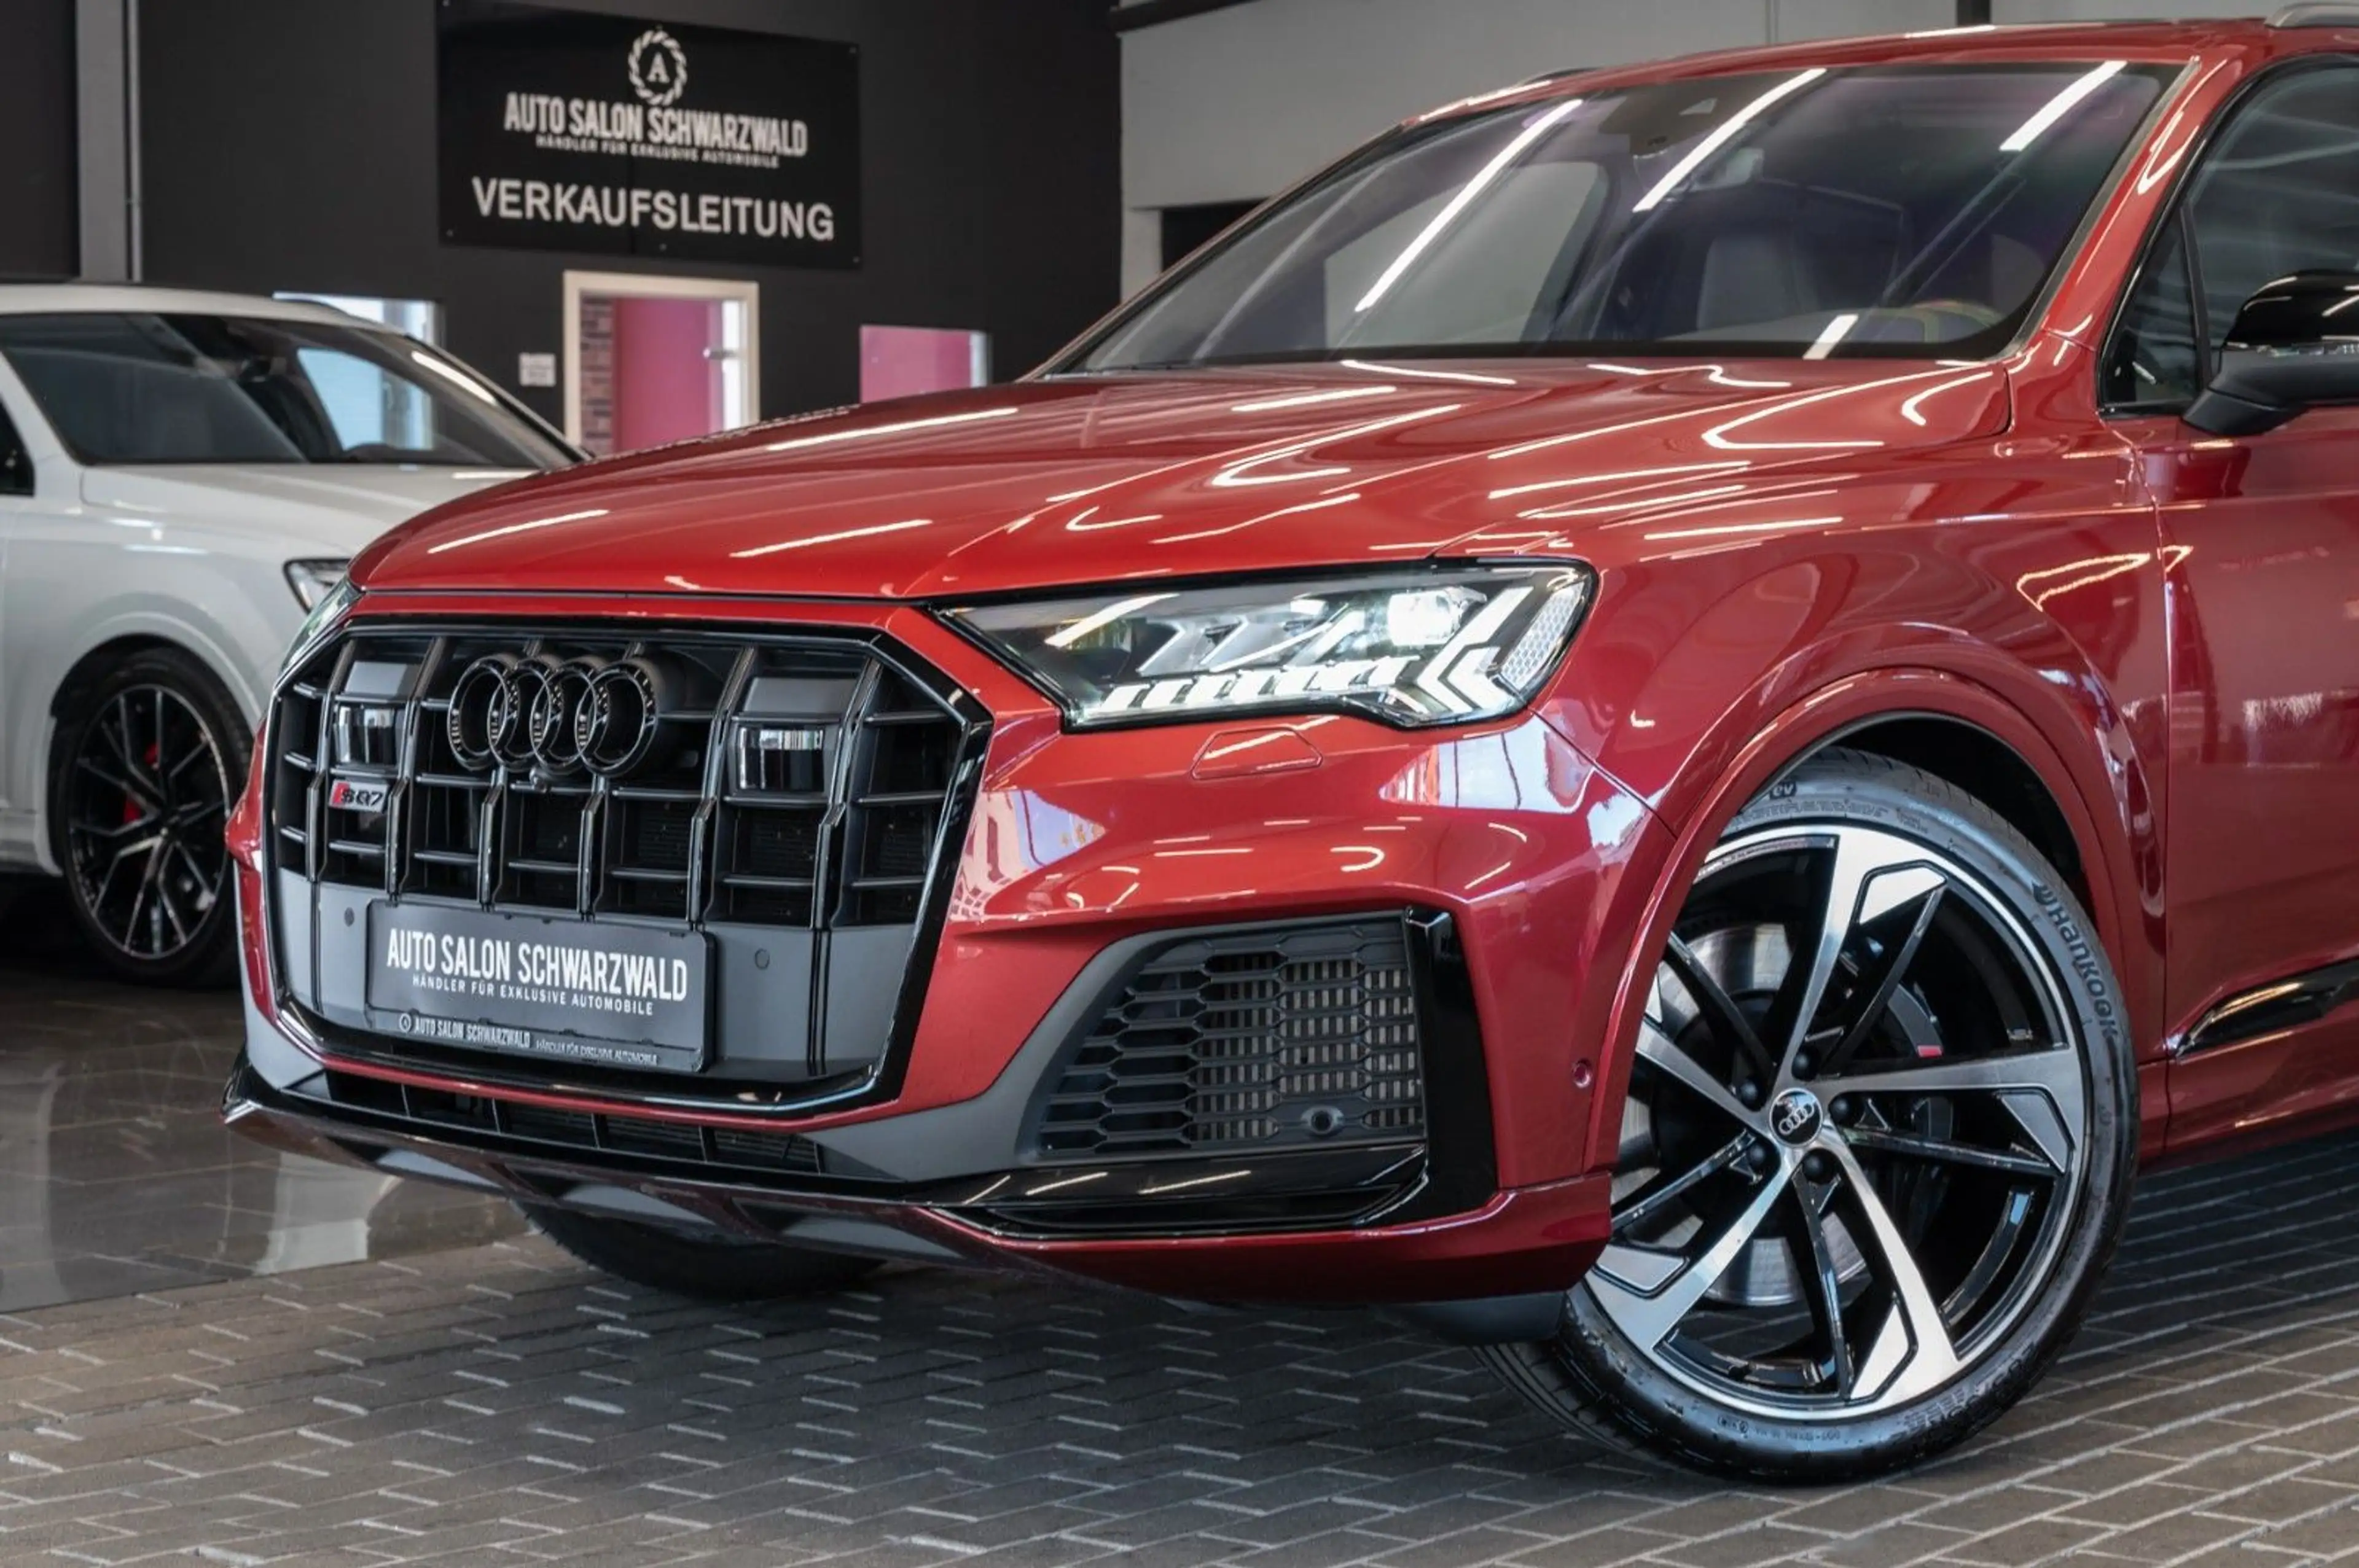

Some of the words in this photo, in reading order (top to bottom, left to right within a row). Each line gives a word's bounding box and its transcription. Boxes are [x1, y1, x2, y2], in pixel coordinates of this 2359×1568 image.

[646, 52, 670, 83] A
[504, 92, 566, 135] AUTO
[569, 99, 643, 141] SALON
[647, 107, 808, 157] SCHWARZWALD
[471, 176, 834, 241] VERKAUFSLEITUNG
[386, 928, 436, 972] AUTO
[441, 934, 511, 981] SALON
[517, 942, 687, 1001] SCHWARZWALD
[413, 972, 466, 993] HÄNDLER
[471, 980, 494, 997] FÜR
[500, 984, 566, 1005] EXKLUSIVE
[571, 993, 654, 1016] AUTOMOBILE
[413, 1016, 436, 1036] AUTO
[437, 1020, 464, 1039] SALON
[466, 1024, 531, 1048] SCHWARZWALD
